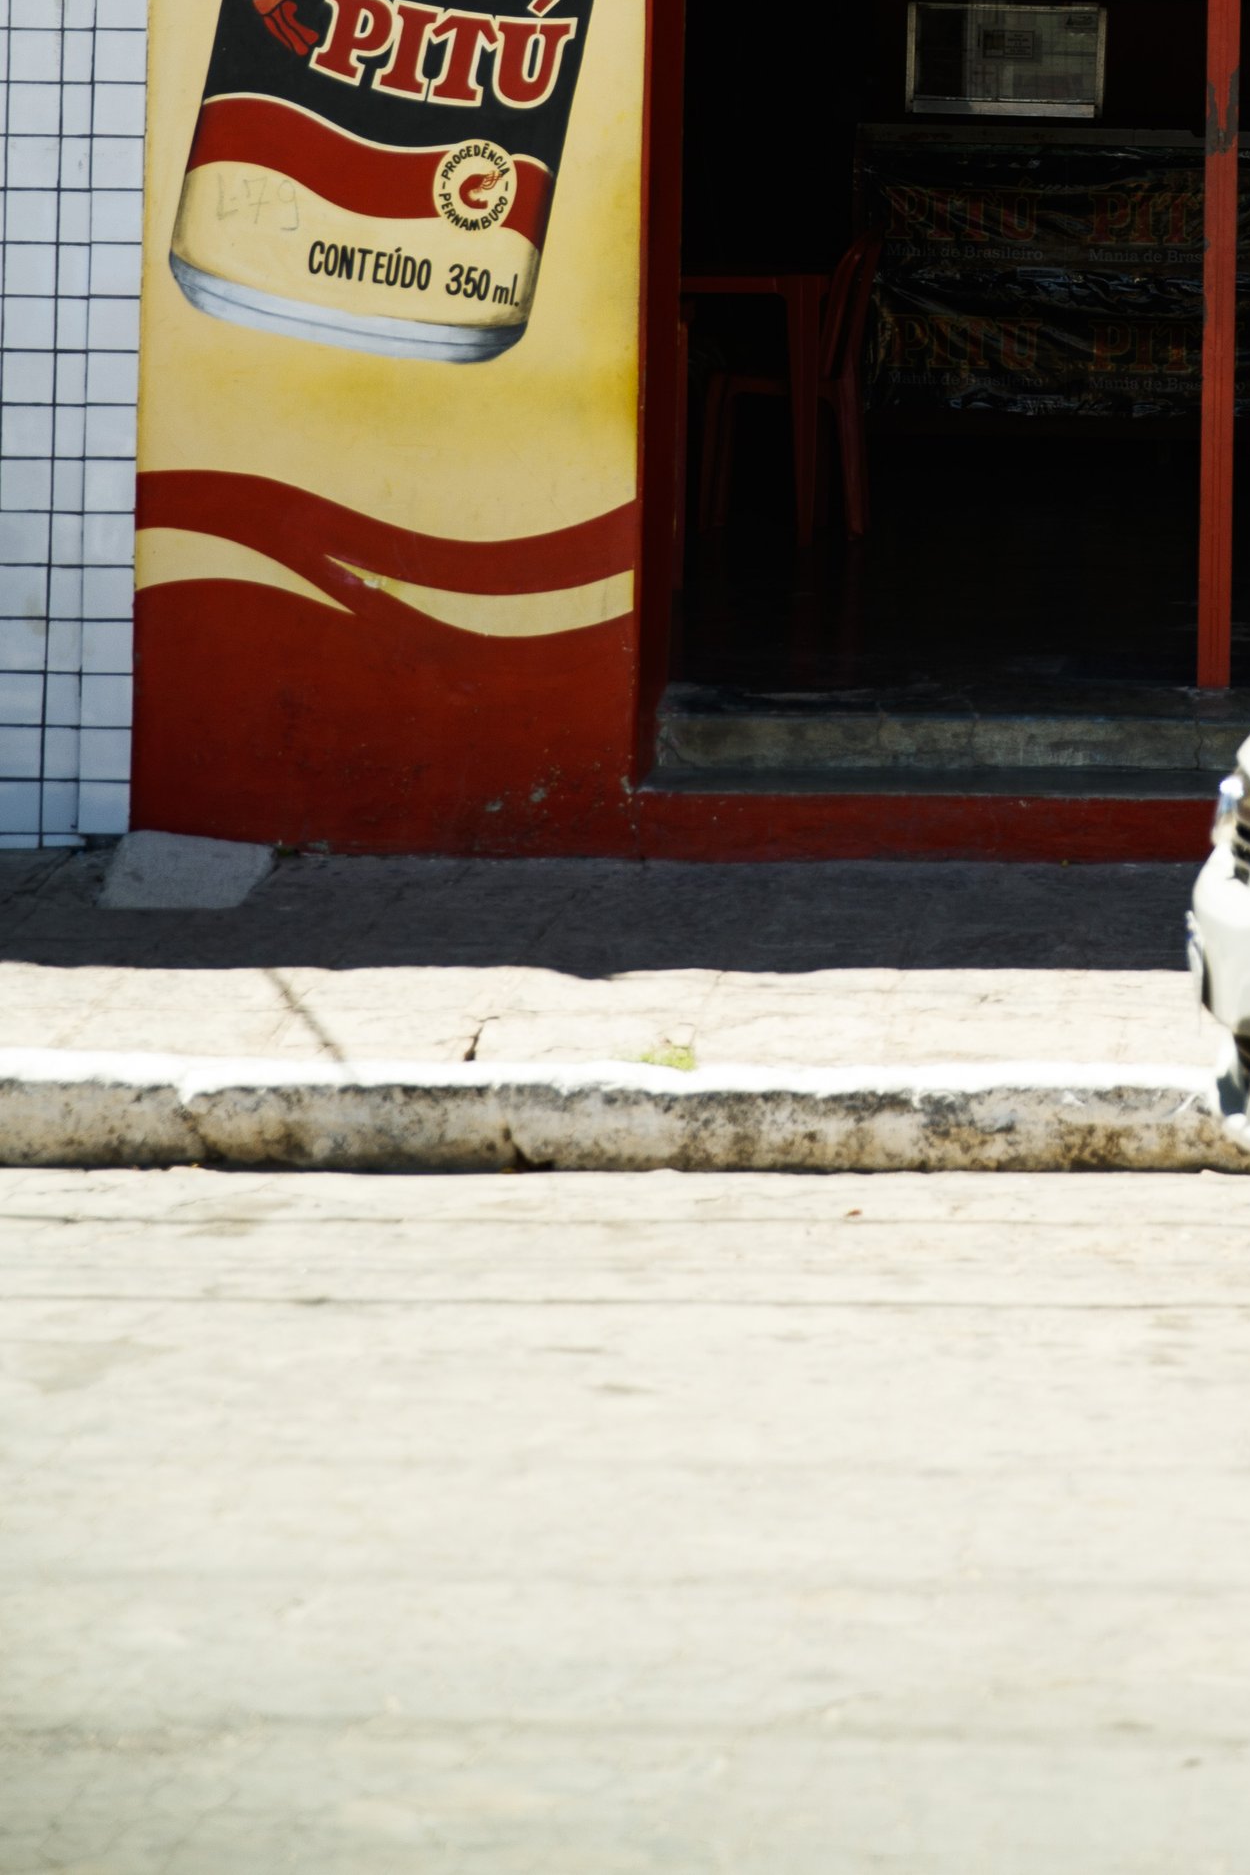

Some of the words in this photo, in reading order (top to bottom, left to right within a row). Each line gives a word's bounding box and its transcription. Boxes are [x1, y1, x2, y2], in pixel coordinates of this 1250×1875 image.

[441, 143, 510, 181] PROCEDÊNCIA
[439, 192, 508, 231] PERNAMBUCO
[1088, 191, 1203, 246] PIT
[308, 240, 431, 291] CONTEÚDO
